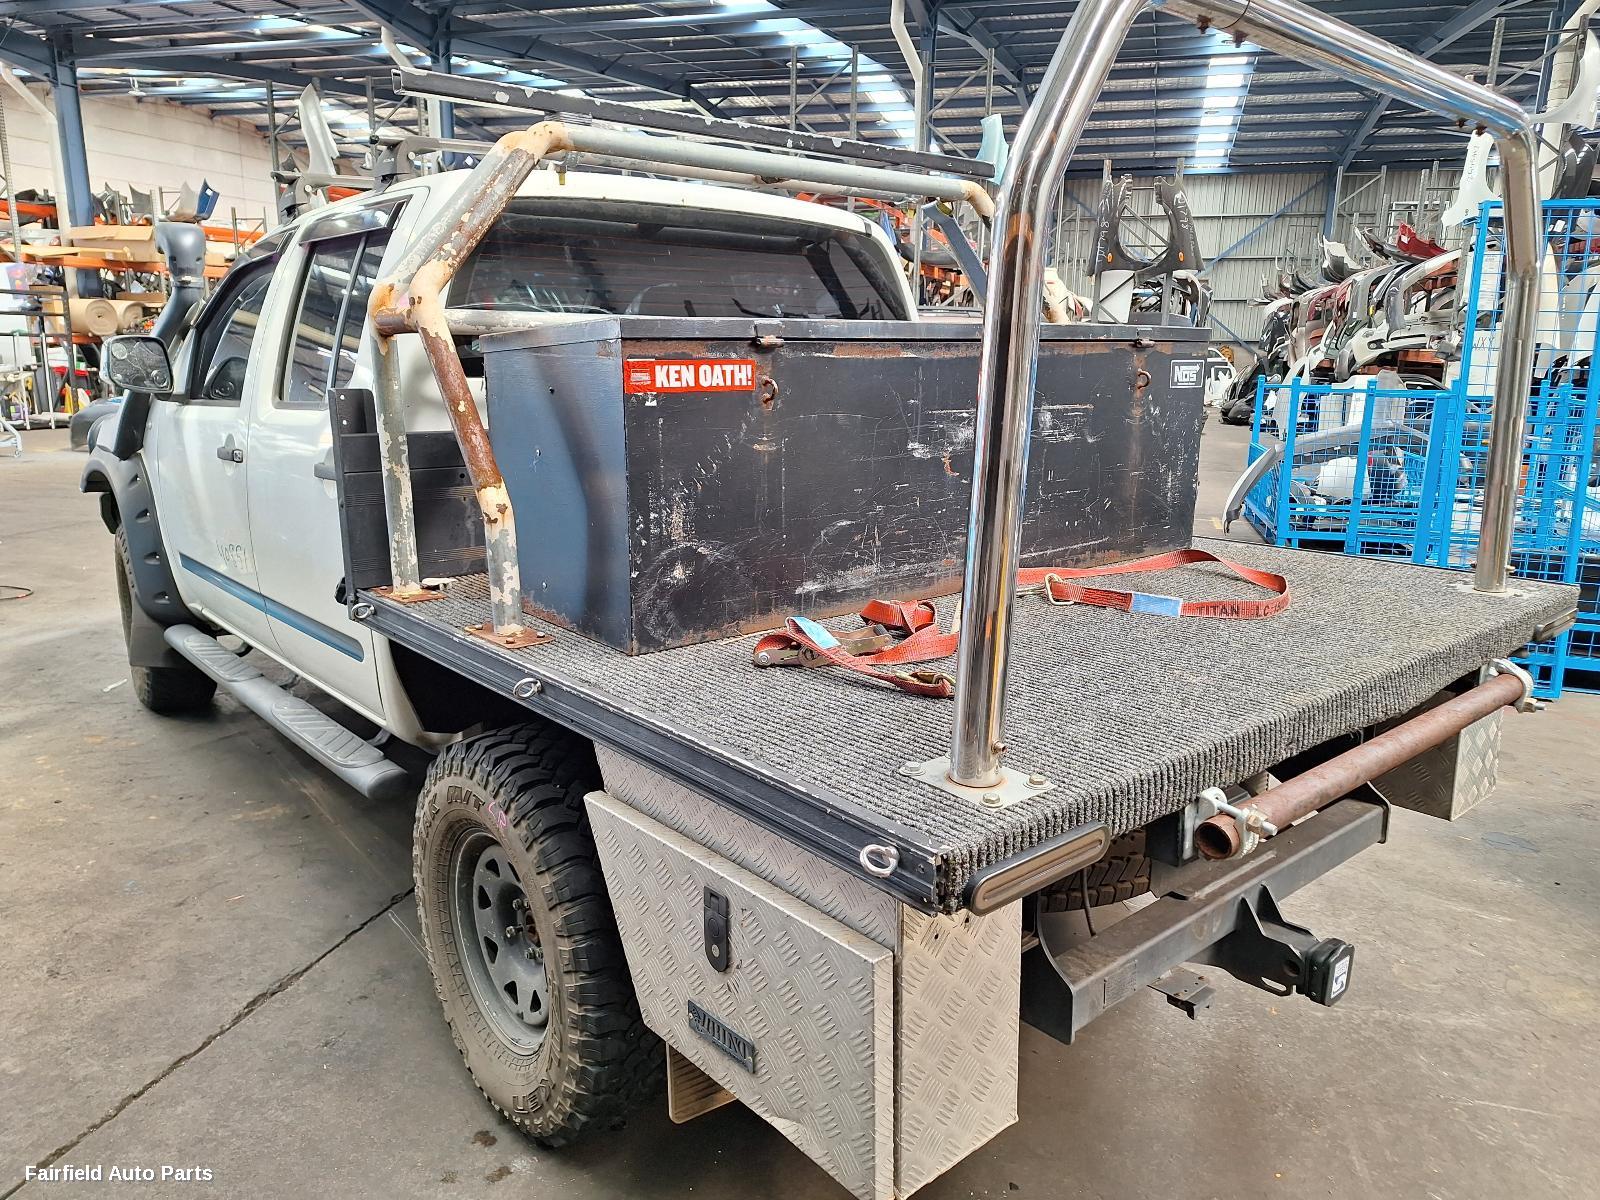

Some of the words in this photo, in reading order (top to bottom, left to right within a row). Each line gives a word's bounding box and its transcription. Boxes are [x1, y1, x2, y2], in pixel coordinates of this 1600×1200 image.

[655, 365, 695, 388] KEN
[699, 364, 752, 388] OATH!
[1174, 364, 1200, 382] NOS
[1196, 605, 1240, 617] TITAN
